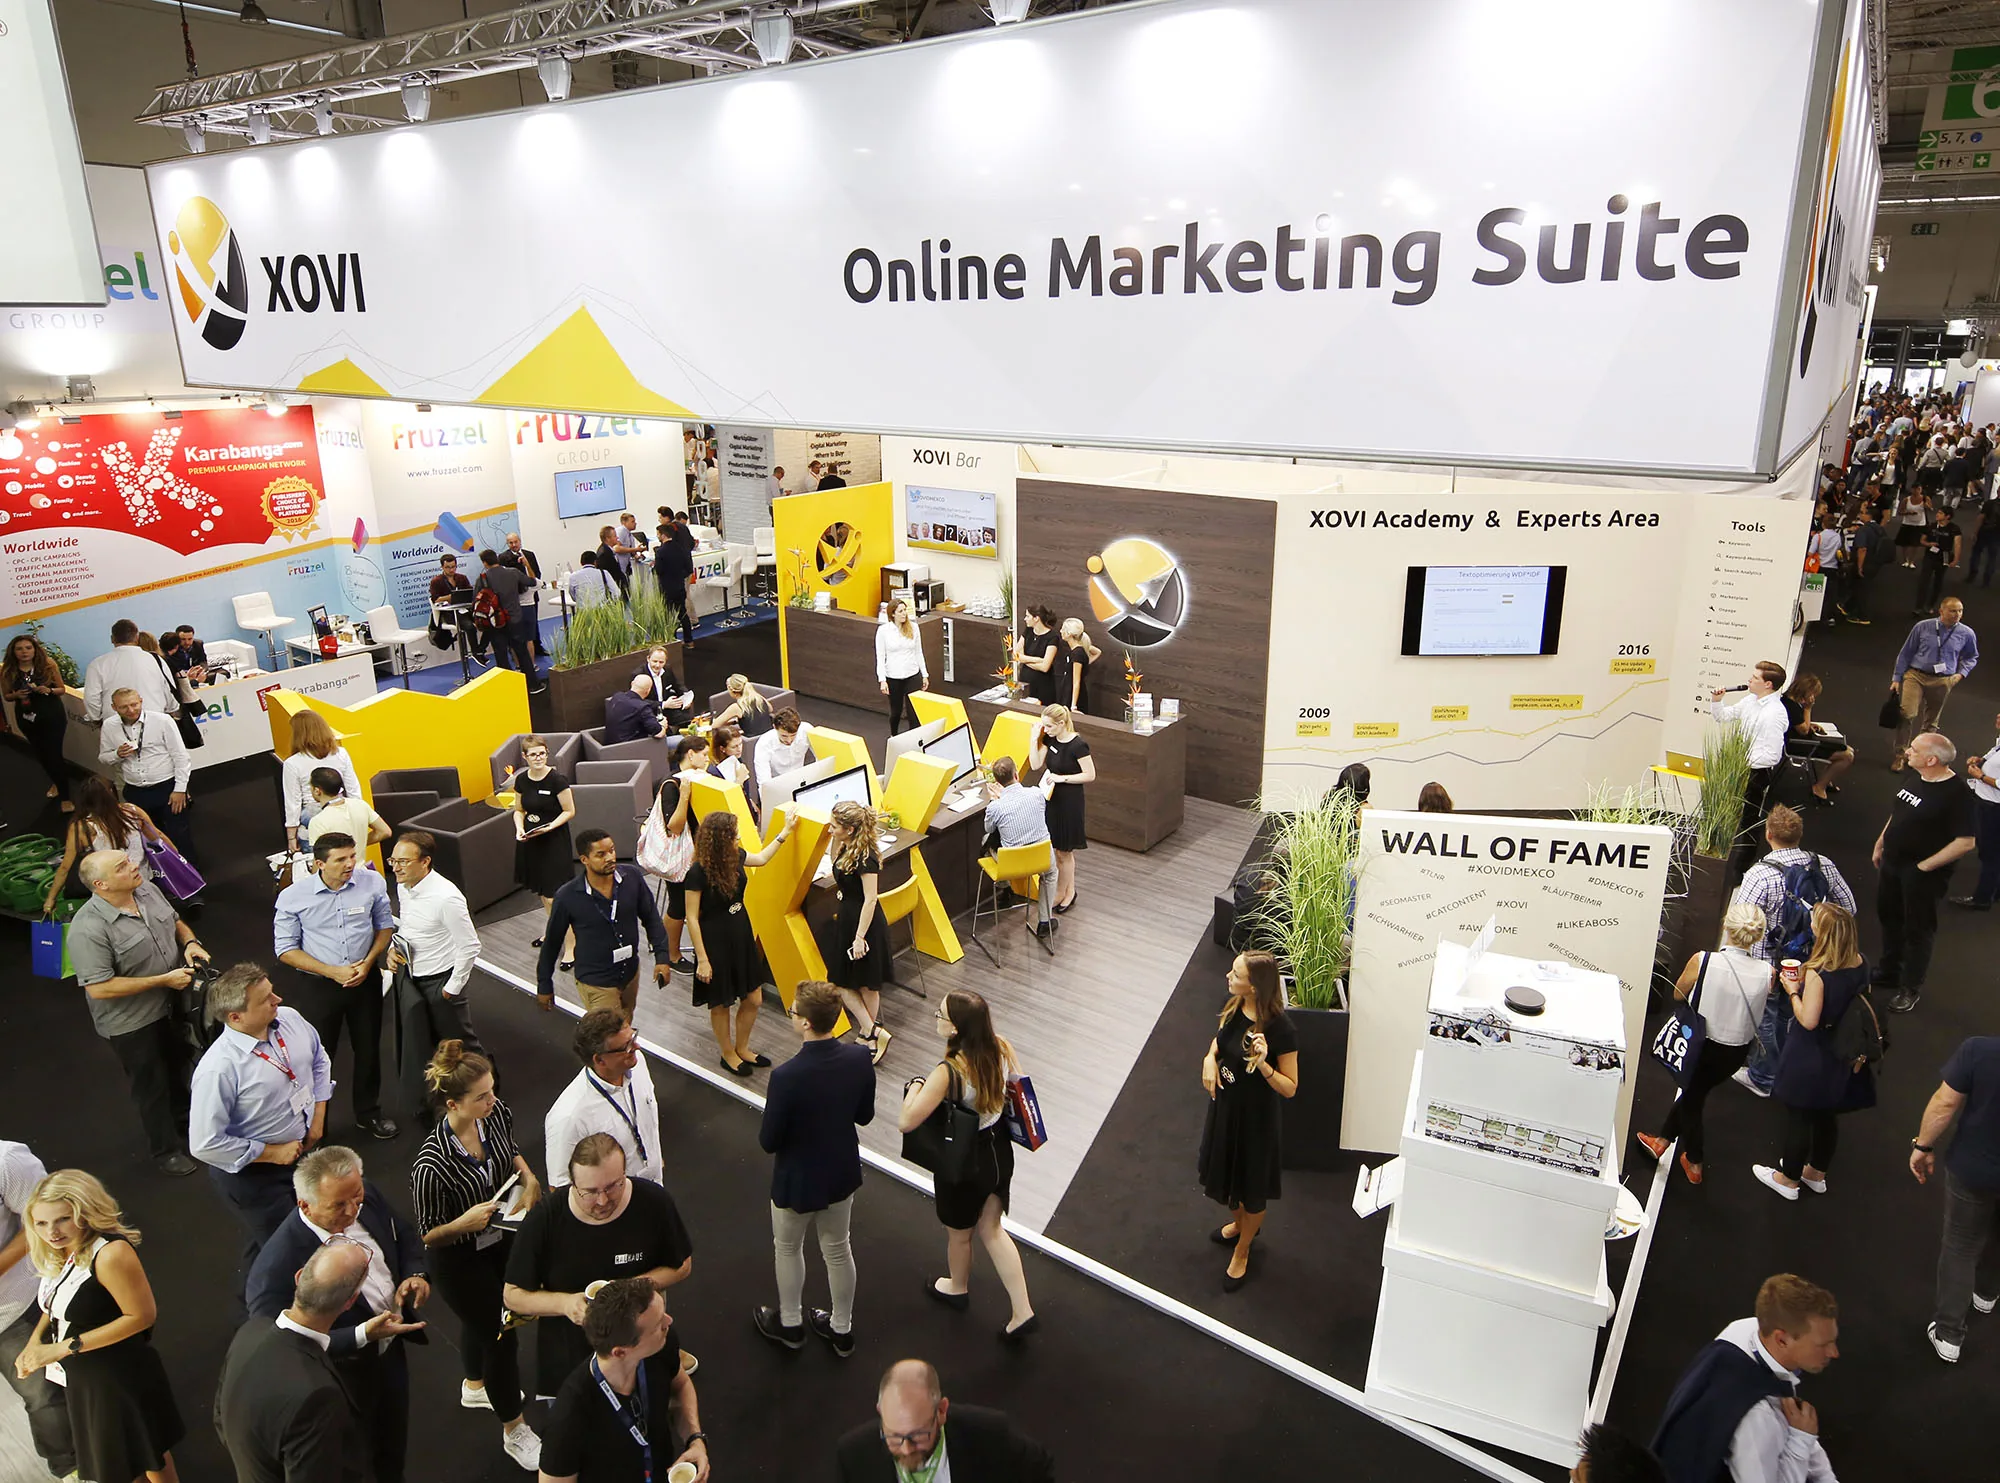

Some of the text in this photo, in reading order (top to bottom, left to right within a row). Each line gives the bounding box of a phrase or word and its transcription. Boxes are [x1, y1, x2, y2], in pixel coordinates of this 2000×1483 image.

[844, 238, 1026, 303] Online
[1049, 213, 1441, 306] Marketing
[1471, 194, 1749, 286] Suite
[105, 251, 159, 301] el
[260, 253, 366, 313] XOVI
[9, 313, 105, 329] GROUP
[392, 420, 487, 450] Fruzzel
[557, 448, 611, 465] GROUP
[913, 448, 981, 468] XOVI Bar
[188, 460, 307, 475] PREMIUM CAMPAIGN NETWORK
[407, 464, 483, 478] www.fruzzel.com
[574, 477, 607, 493] Fruzzel
[1309, 509, 1660, 532] XOVI Academy & Experts Area
[1731, 520, 1766, 533] Tools
[3, 537, 79, 554] Worldwide
[392, 545, 444, 560] Worldwide
[43, 551, 81, 561] CAMPAIGNS
[14, 559, 87, 573] TRAFFIC MANAGEMENT
[53, 566, 89, 576] MARKETING
[288, 562, 326, 576] Fruzzel
[694, 556, 725, 579] zzel
[18, 573, 95, 589] CUSTOMER ACQUISITION
[1458, 571, 1511, 579] Textoptimierung
[20, 583, 80, 596] MEDIA BROKERAGE
[1805, 583, 1823, 591] C18
[21, 591, 80, 605] LEAD GENERATION
[1618, 644, 1650, 655] 2016
[1298, 707, 1331, 718] 2009
[1896, 788, 1922, 807] RTFM
[1381, 829, 1650, 869] WALL OF FAME
[1420, 868, 1445, 881] #TLNR
[1467, 864, 1555, 879] #XOVIDMEXCO
[1587, 876, 1645, 899] #DMEXCO16
[1379, 893, 1432, 907] #SEOMASTER
[1426, 888, 1487, 920] #CATCONTENT
[1496, 900, 1528, 909] #XOVI
[1367, 911, 1425, 943] #ICHWARHIER
[1459, 924, 1518, 935] #AWOME
[1556, 918, 1619, 929] #LIKEABOSS
